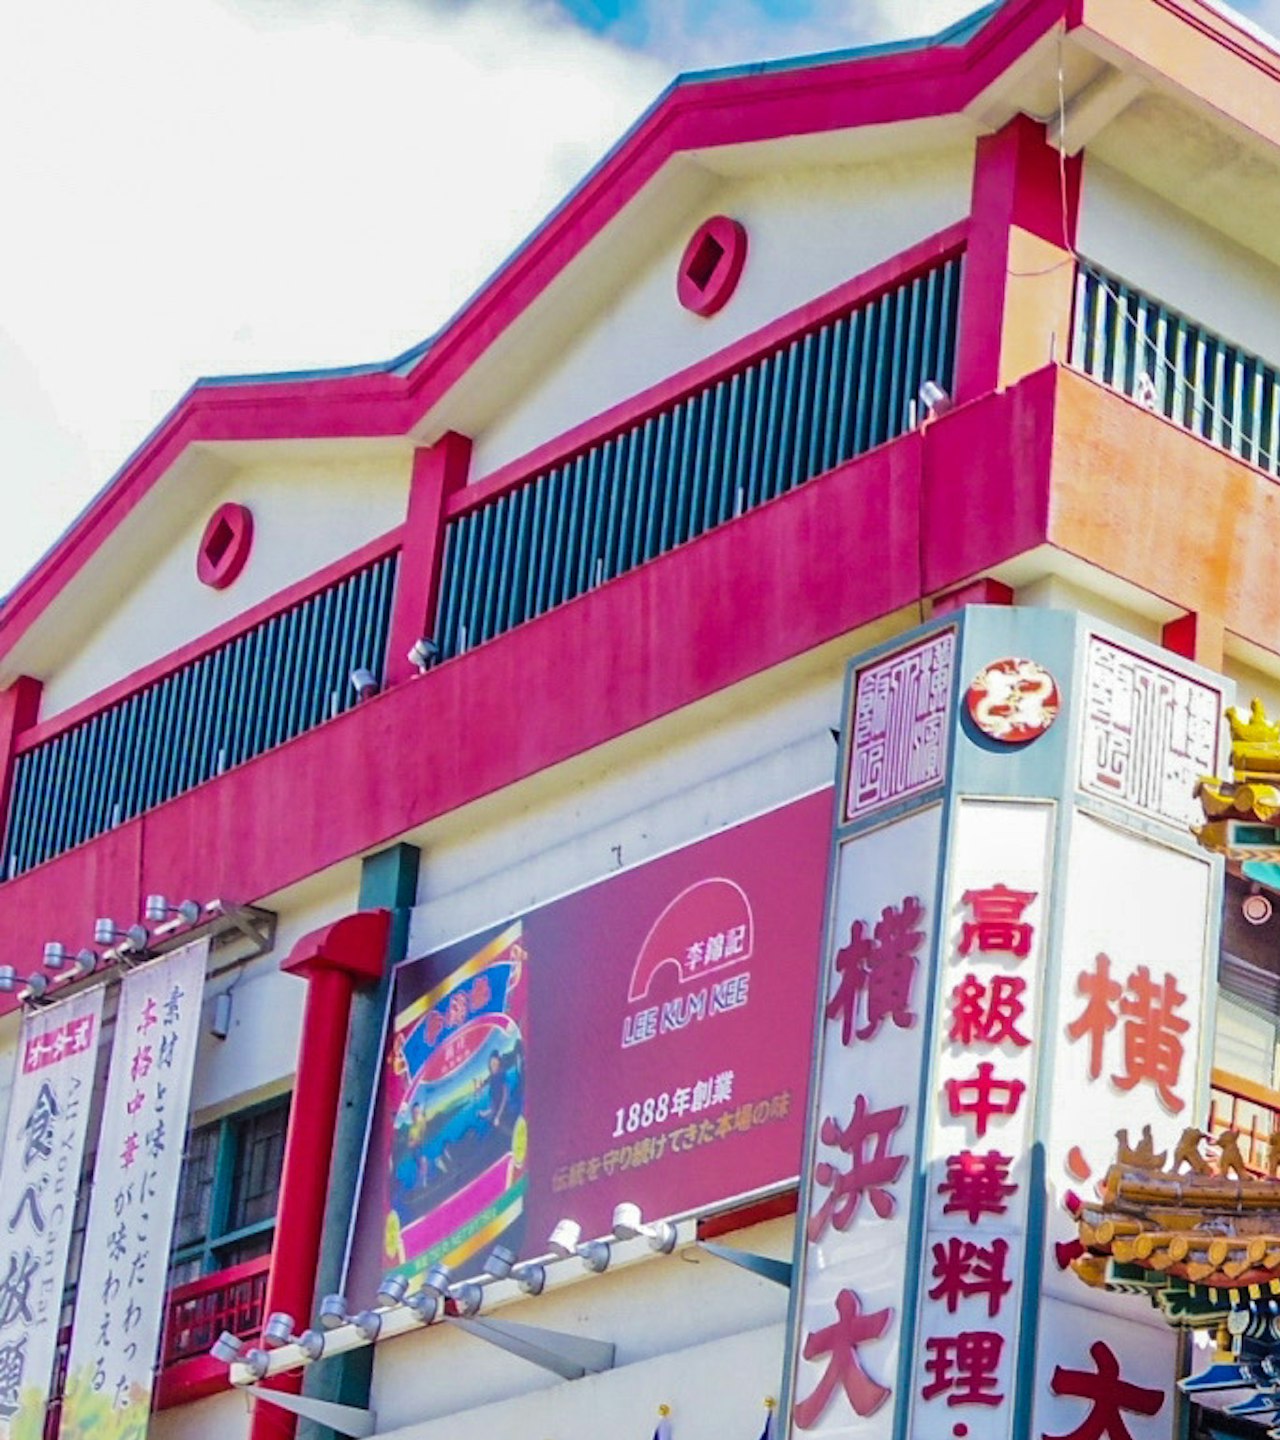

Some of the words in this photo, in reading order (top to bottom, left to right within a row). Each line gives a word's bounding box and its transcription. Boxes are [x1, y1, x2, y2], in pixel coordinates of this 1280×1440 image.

[685, 924, 747, 971] 李錦記
[621, 1006, 658, 1049] LEE
[659, 988, 708, 1035] KUM
[708, 971, 750, 1016] KEE
[611, 1069, 735, 1138] 1888年創業
[0, 1080, 60, 1420] 食べ放題
